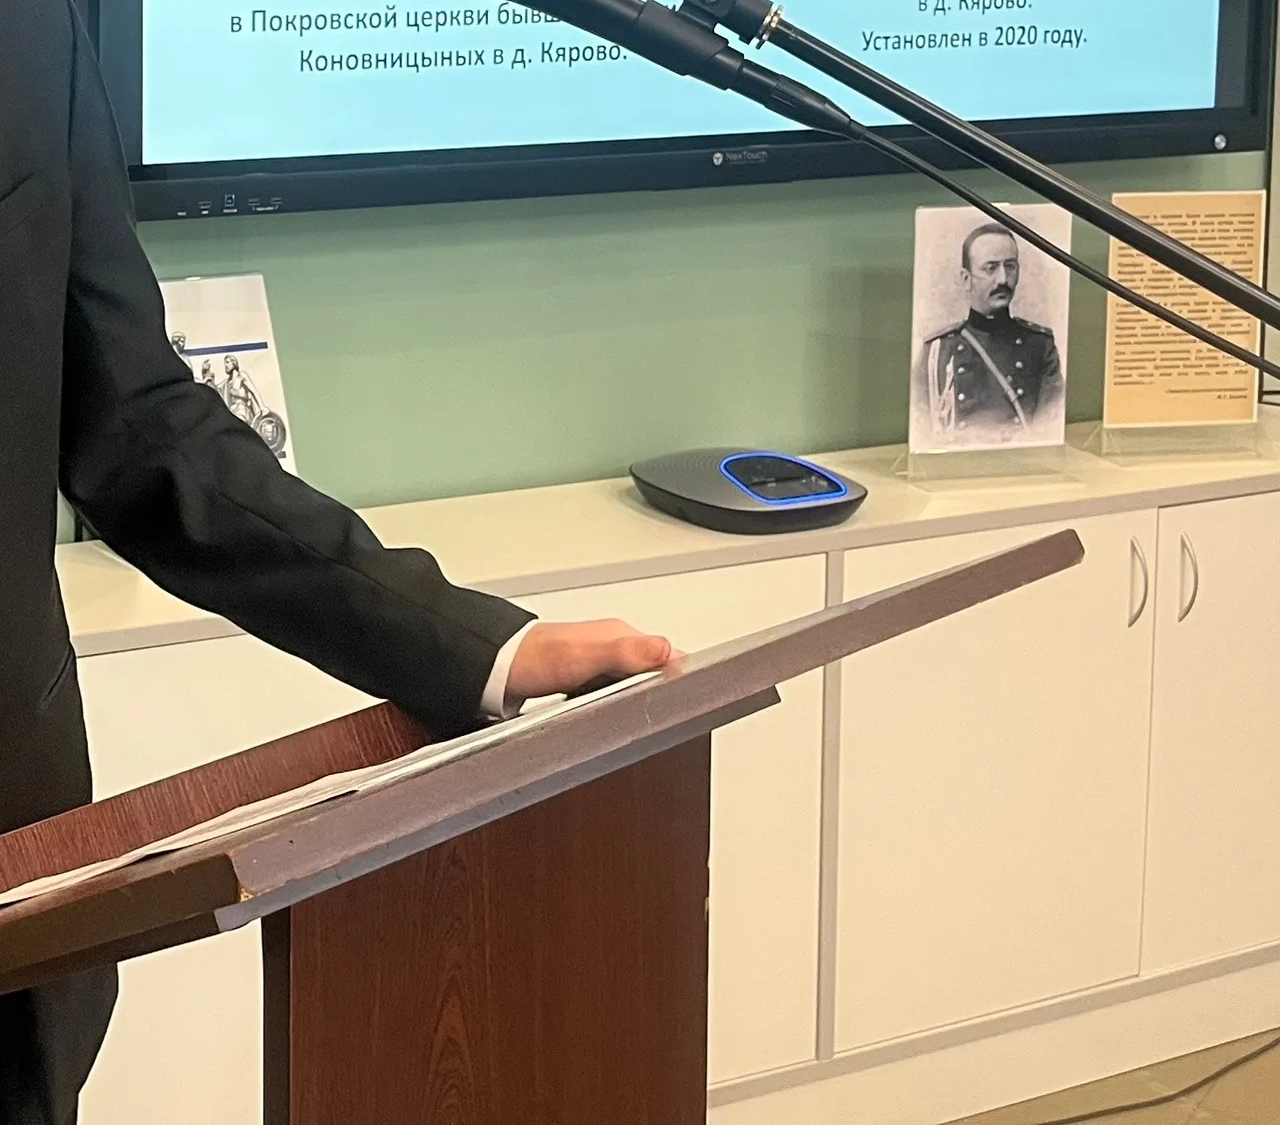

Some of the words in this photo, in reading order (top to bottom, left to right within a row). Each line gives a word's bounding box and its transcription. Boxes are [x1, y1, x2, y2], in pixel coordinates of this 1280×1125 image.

[231, 16, 242, 32] в
[252, 5, 397, 37] Покровской
[406, 9, 489, 33] церкви
[862, 30, 972, 51] Установлен
[979, 33, 988, 48] в
[994, 25, 1038, 47] 2020
[1043, 28, 1088, 49] году.
[300, 50, 485, 73] Коновницыных
[493, 47, 504, 64] в
[511, 48, 532, 69] д.
[541, 42, 627, 67] Кярово.
